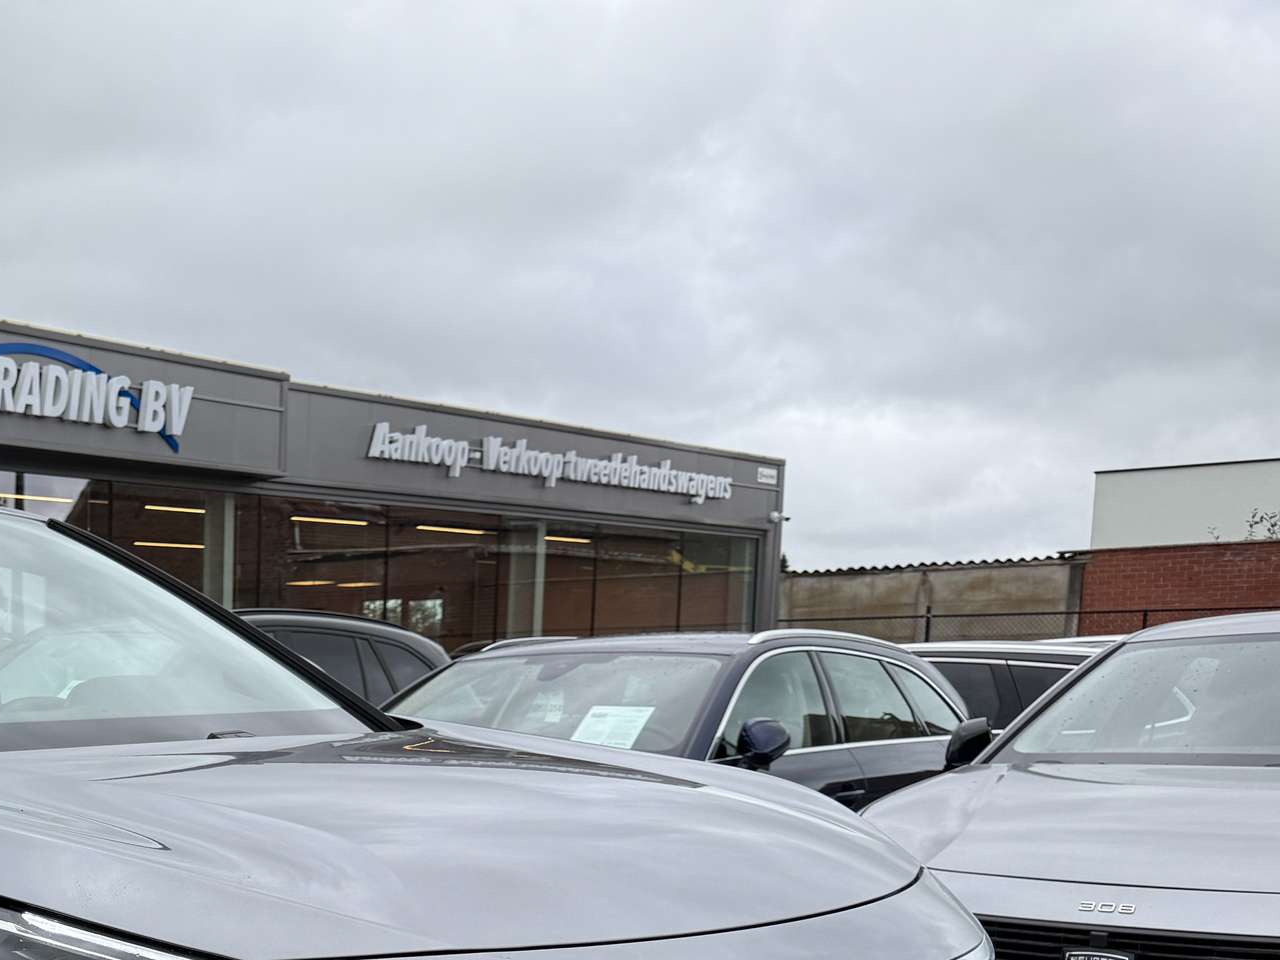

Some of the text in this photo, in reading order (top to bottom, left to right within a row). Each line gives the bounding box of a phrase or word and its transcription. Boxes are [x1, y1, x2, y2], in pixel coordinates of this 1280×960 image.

[137, 379, 194, 436] BV
[368, 421, 469, 477] Aankoop
[482, 436, 564, 488] Verkoop
[564, 450, 733, 505] tweedehandswagens
[1078, 900, 1136, 914] 308
